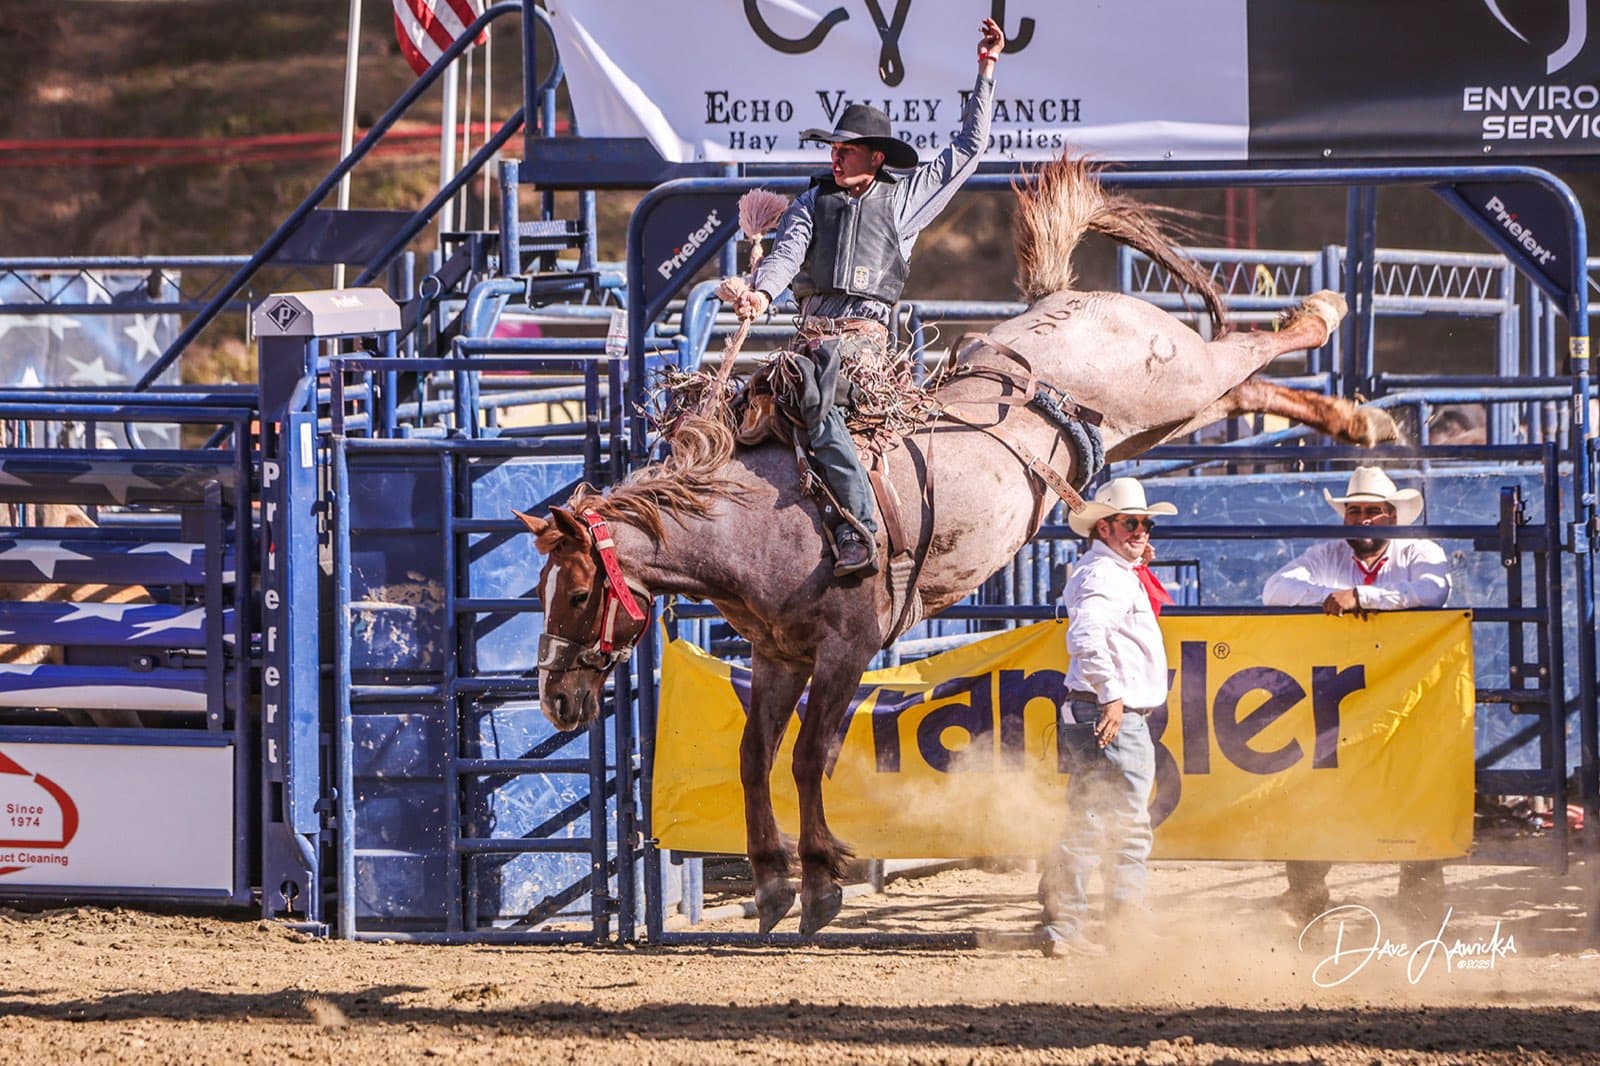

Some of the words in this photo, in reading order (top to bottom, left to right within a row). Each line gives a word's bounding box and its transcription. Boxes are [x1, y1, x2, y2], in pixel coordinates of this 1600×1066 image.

[816, 90, 942, 123] VLEY
[1463, 85, 1599, 111] ENVIRO
[729, 131, 778, 154] Hay
[901, 131, 939, 149] Pet
[950, 129, 1062, 153] Spplies
[1485, 196, 1551, 265] Priefert
[657, 211, 722, 280] Priefert
[263, 461, 280, 763] Priefert
[7, 803, 43, 814] Since
[10, 817, 40, 827] 1974
[18, 853, 68, 866] Cleaning
